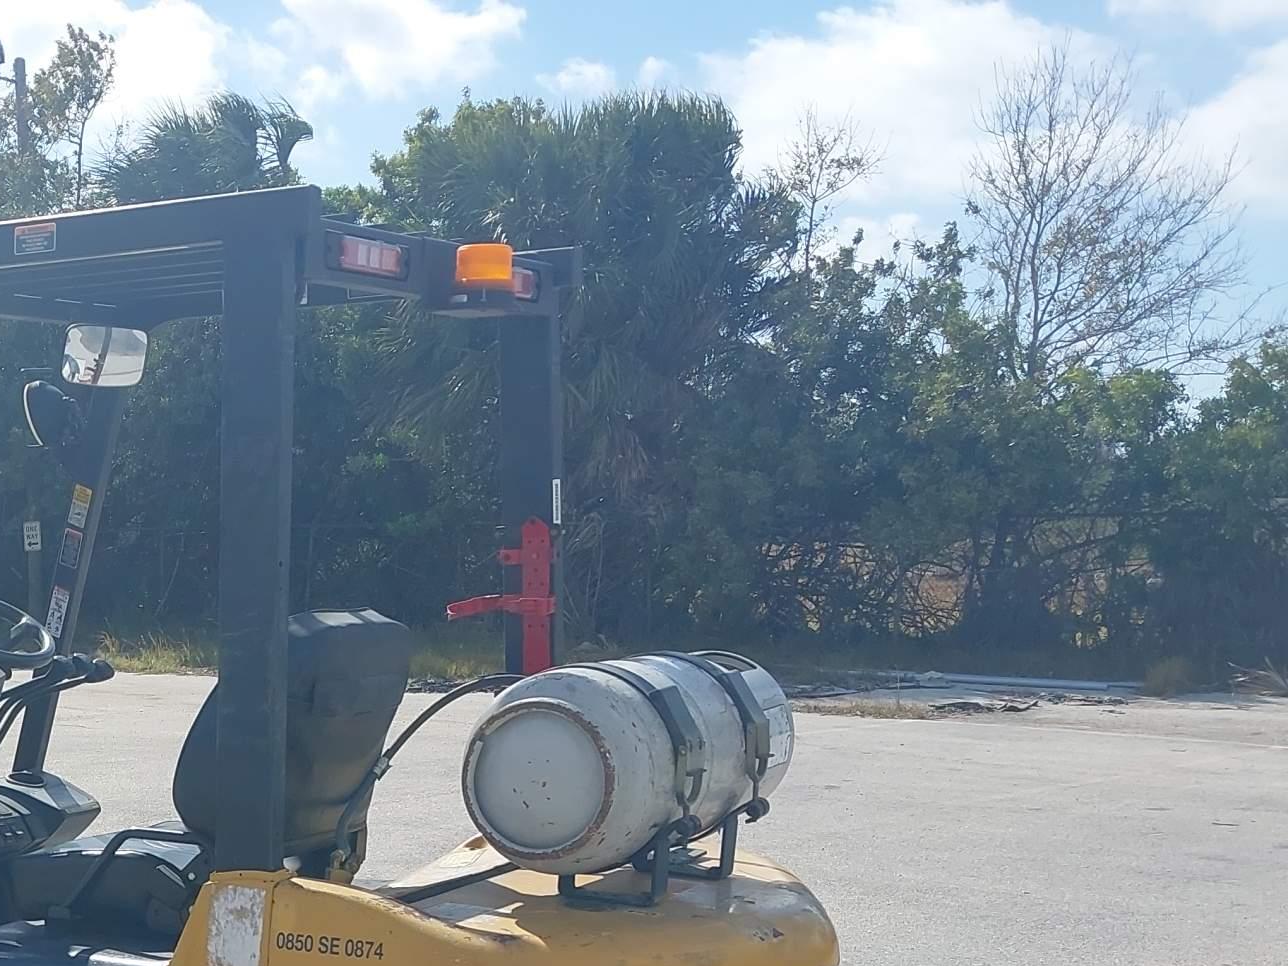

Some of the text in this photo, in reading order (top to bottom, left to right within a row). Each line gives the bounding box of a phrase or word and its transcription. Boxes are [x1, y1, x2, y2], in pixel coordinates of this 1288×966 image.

[25, 525, 38, 533] ONE
[276, 932, 384, 960] 0850 SE 0874
